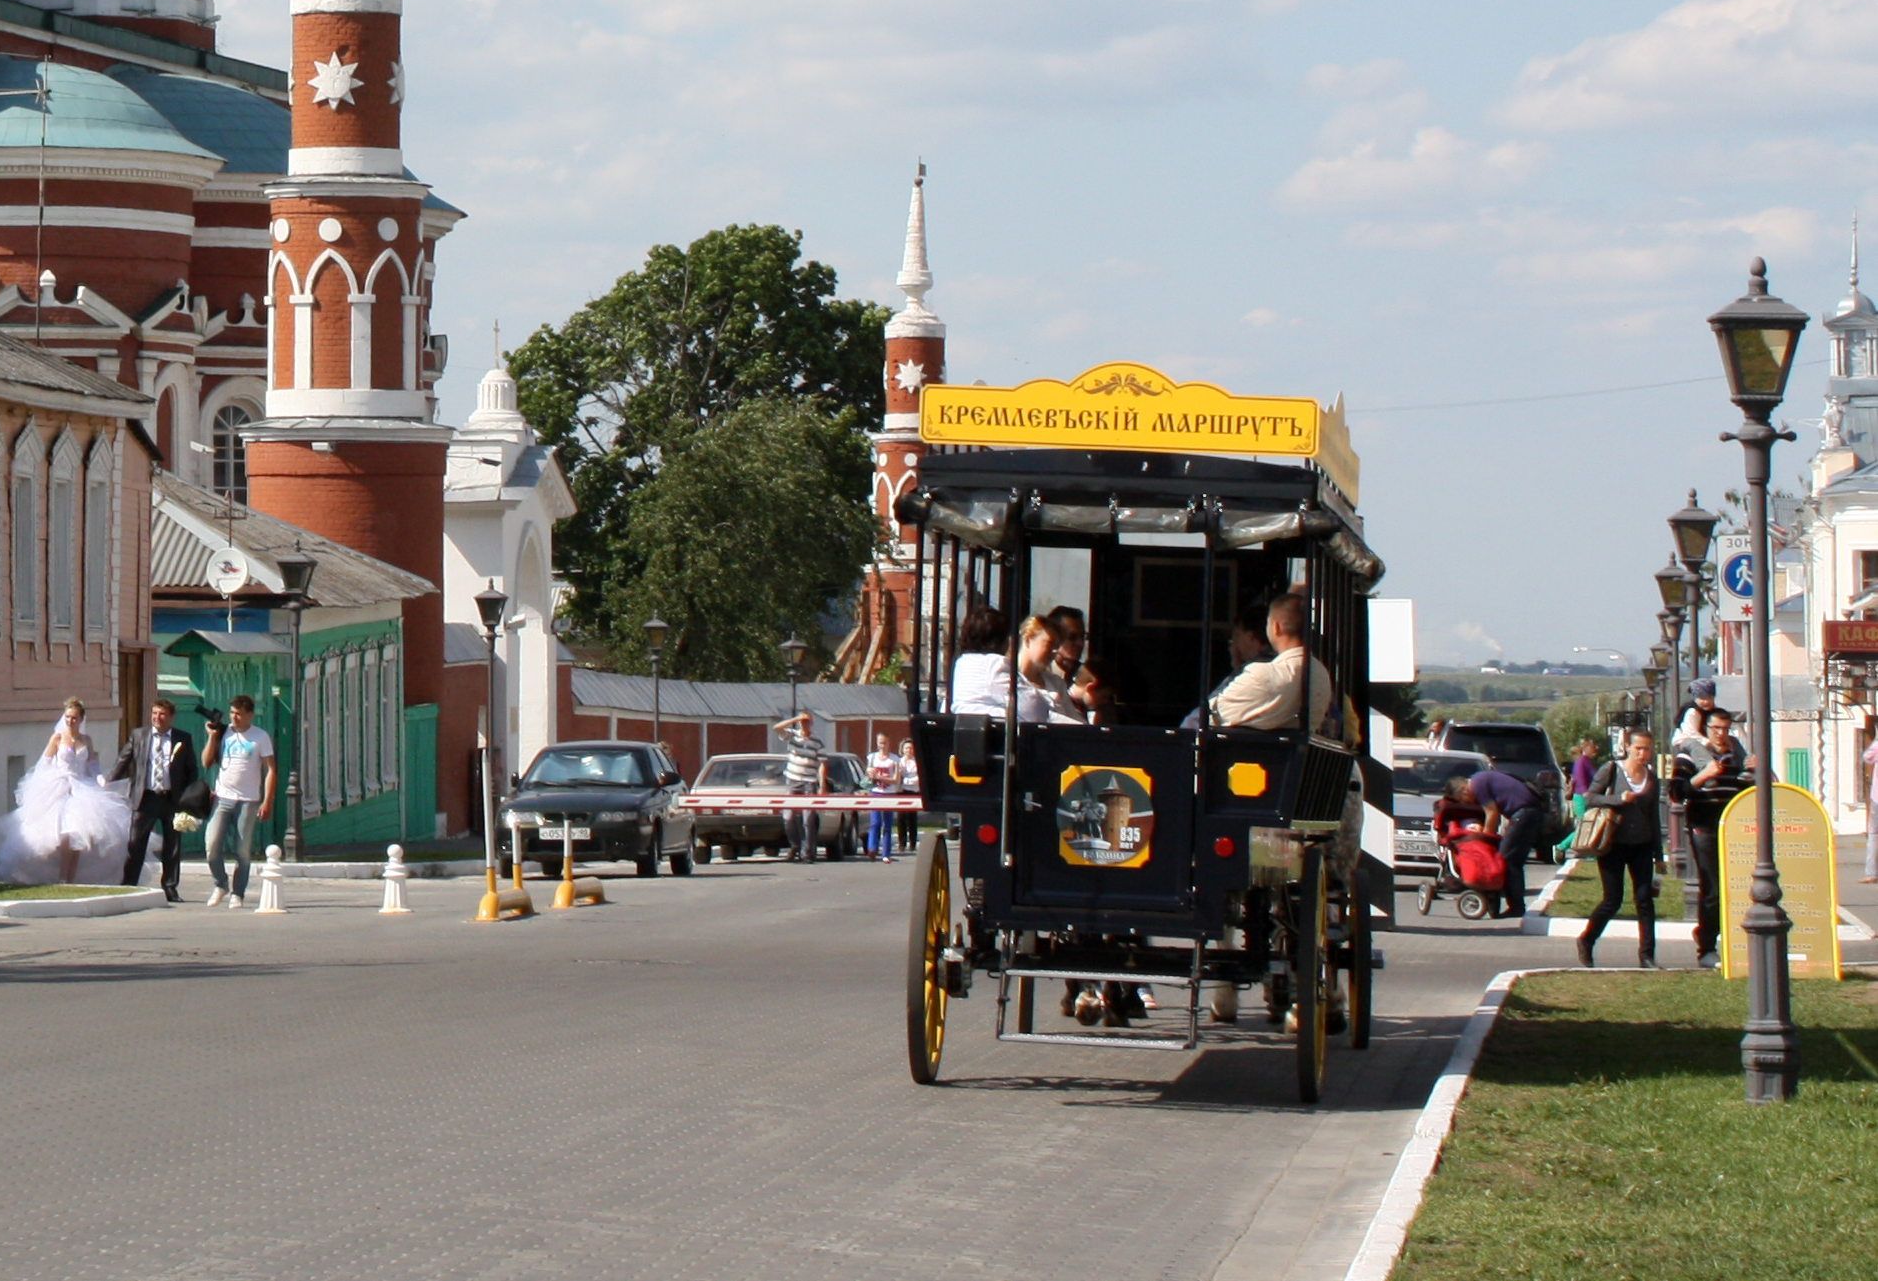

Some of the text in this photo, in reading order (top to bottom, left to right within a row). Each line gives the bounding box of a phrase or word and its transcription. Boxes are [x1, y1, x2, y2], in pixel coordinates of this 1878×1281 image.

[1151, 412, 1304, 442] МАРШРУТЪ
[1726, 538, 1752, 548] ЗОН
[1119, 826, 1141, 842] 835
